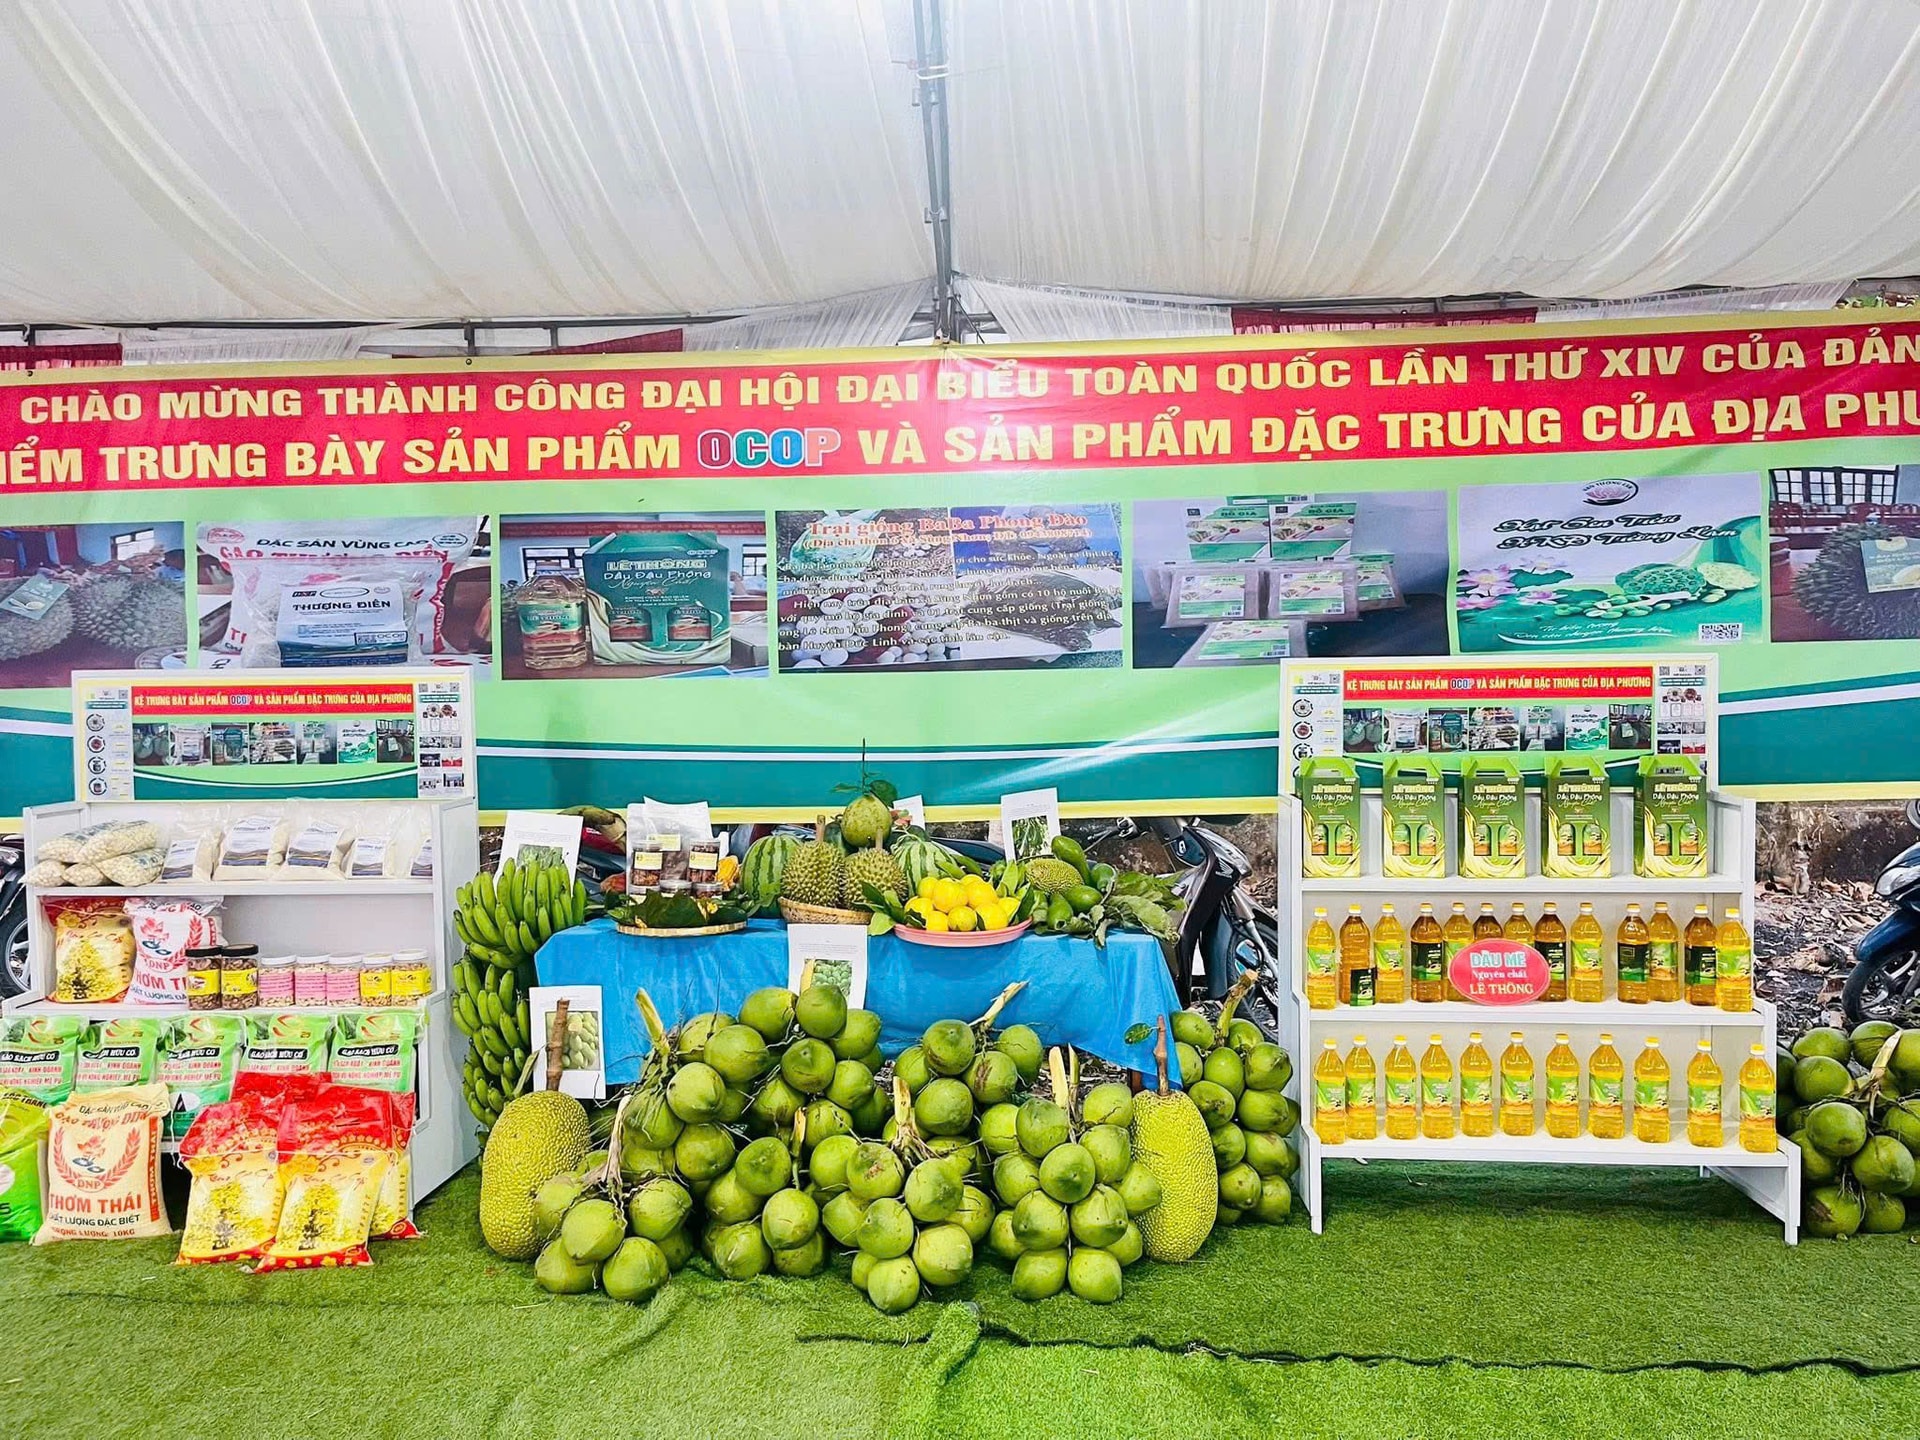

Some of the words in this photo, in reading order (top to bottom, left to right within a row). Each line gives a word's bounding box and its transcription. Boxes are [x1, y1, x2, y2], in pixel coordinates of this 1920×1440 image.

[21, 389, 142, 424] CHÀO
[159, 384, 301, 420] MỪNG
[318, 380, 478, 416] THÀNH
[494, 378, 626, 413] CÔNG
[641, 376, 722, 414] ĐẠI
[740, 371, 820, 413] HỘI
[836, 372, 919, 410] ĐẠI
[937, 358, 1049, 401] BIỂU
[1065, 359, 1198, 397] TOÀN
[1216, 349, 1352, 391] QUỐC
[1369, 346, 1469, 386] LẦN
[1485, 344, 1588, 381] THỨ
[1599, 345, 1685, 377] XIV
[1702, 332, 1804, 372] CỦA
[99, 441, 267, 480] TRƯNG
[286, 434, 385, 477] BÀY
[404, 425, 510, 474] SẢN
[531, 420, 680, 471] PHẨM
[697, 428, 841, 469] OCOP
[858, 420, 926, 465] VÀ
[944, 414, 1053, 461] SẢN
[1073, 404, 1231, 459] PHẨM
[1250, 408, 1374, 460] ĐẶC
[1378, 405, 1564, 449] TRƯNG
[1581, 392, 1695, 440] CỦA
[1712, 396, 1804, 441] ĐỊA
[809, 522, 851, 537] Trại
[857, 517, 914, 538] giống
[980, 513, 1044, 530] Phong
[1021, 589, 1034, 598] có
[1037, 589, 1050, 598] 10
[1053, 588, 1067, 598] hộ
[1070, 585, 1091, 596] nuôi
[885, 608, 908, 618] đình
[1018, 600, 1048, 613] giống
[1001, 616, 1022, 627] thịt
[1024, 615, 1037, 624] và
[1040, 613, 1070, 626] giống
[872, 637, 897, 647] Linh
[1451, 678, 1475, 690] OCOP
[1476, 677, 1488, 689] VÀ
[1469, 981, 1487, 995] LÊ
[1488, 981, 1534, 995] THÔNG
[77, 1179, 101, 1189] DNP
[50, 1193, 91, 1214] THƠM
[97, 1192, 142, 1214] THÁI
[65, 1216, 96, 1226] LƯỢNG
